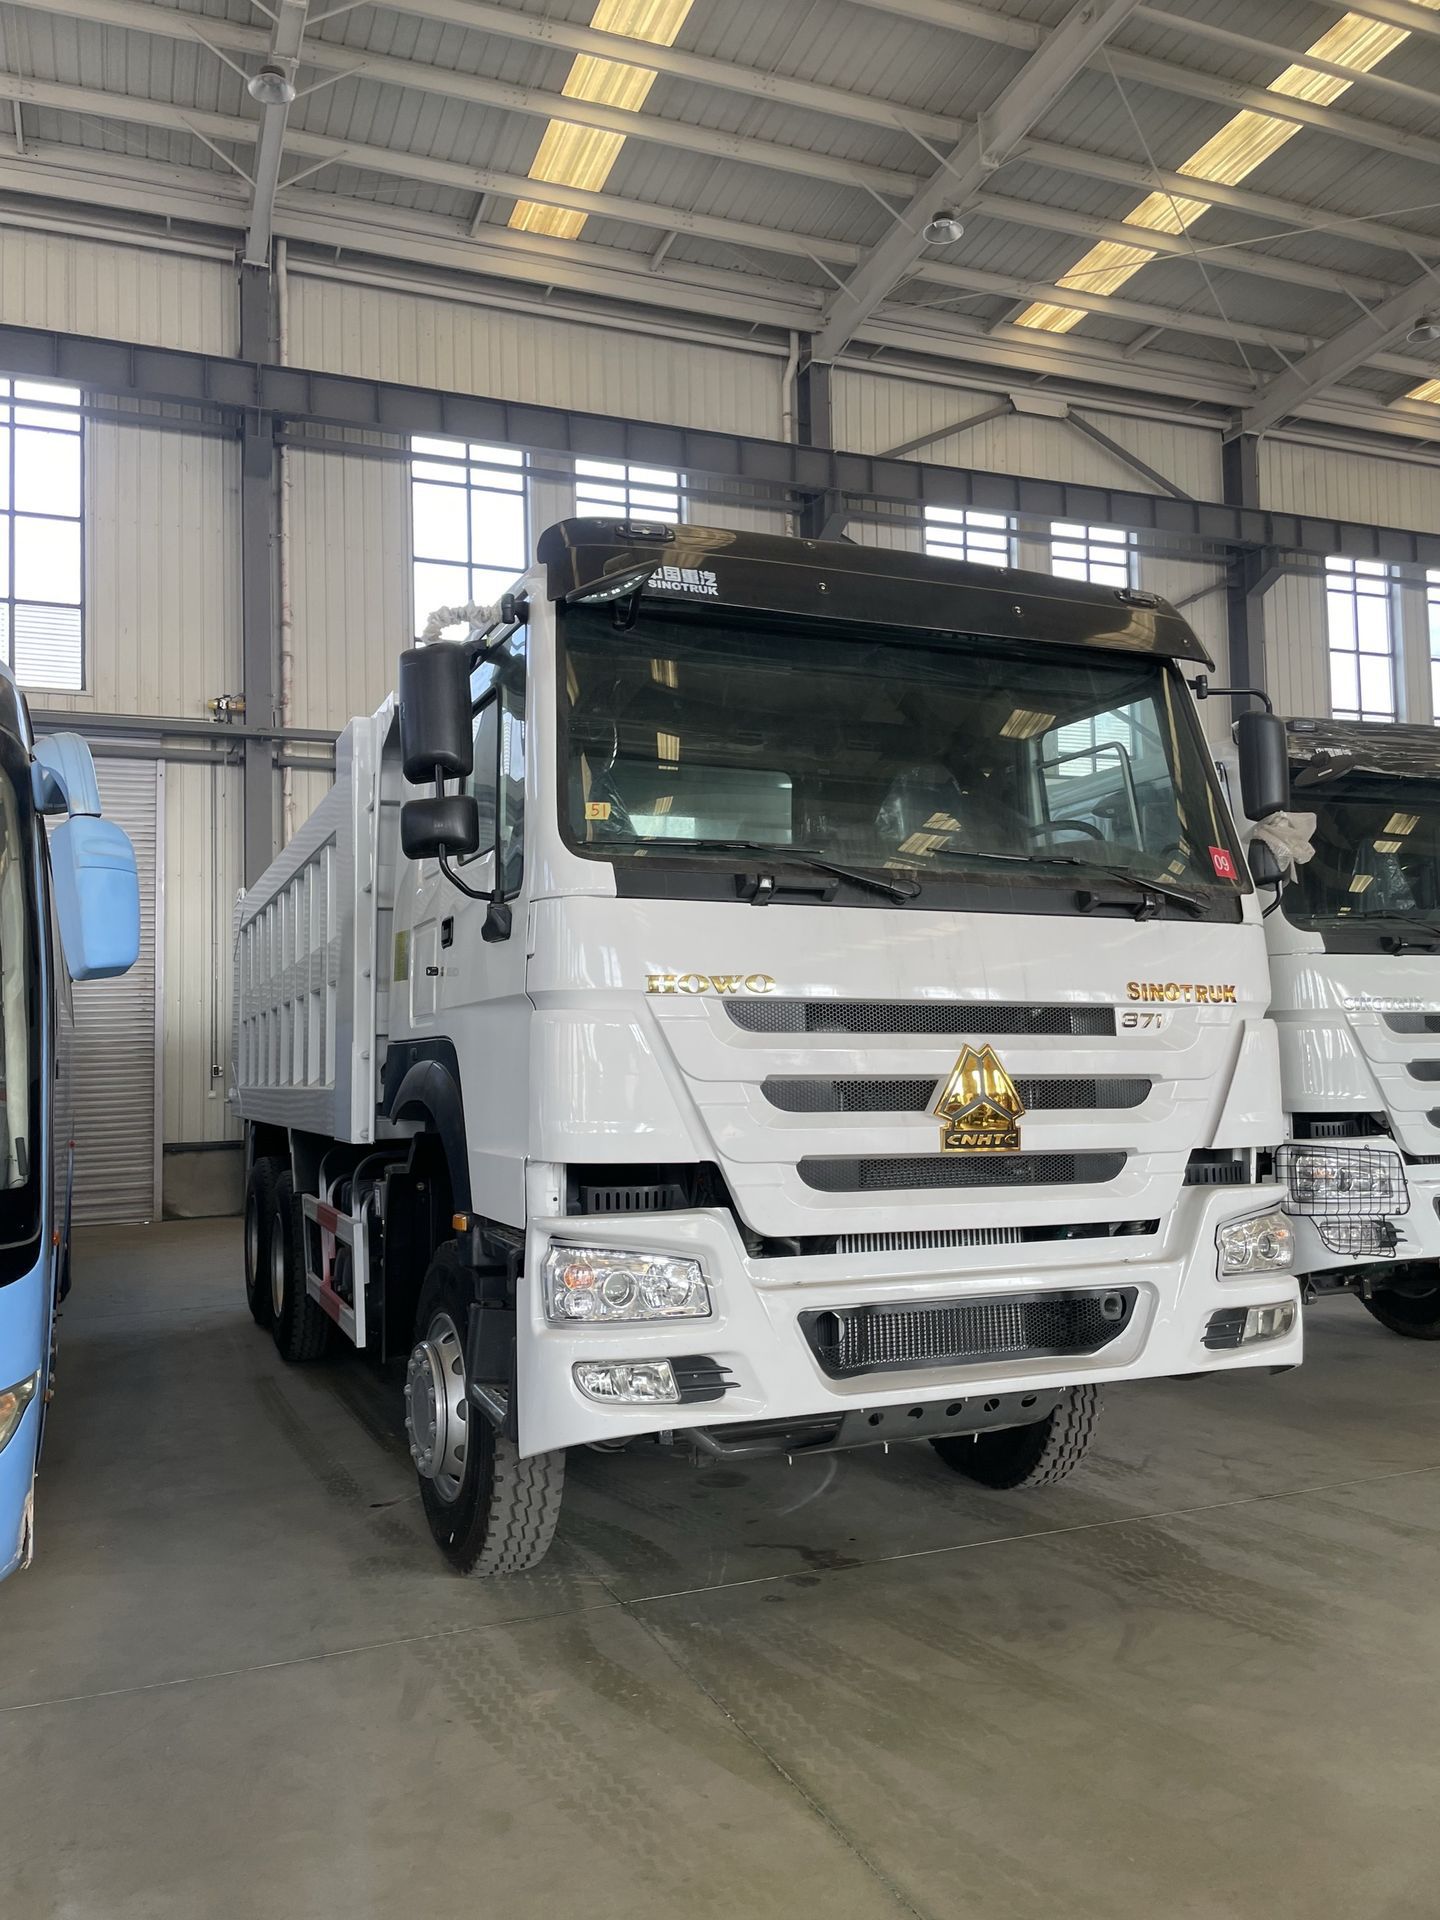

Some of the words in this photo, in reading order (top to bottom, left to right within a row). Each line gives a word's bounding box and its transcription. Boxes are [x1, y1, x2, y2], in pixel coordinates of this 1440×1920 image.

[647, 579, 719, 596] SINOTRUK
[591, 803, 606, 817] 51
[1214, 854, 1230, 872] 09
[645, 973, 777, 994] HOWO
[1126, 981, 1238, 1004] SINOTRUK
[1121, 1012, 1163, 1029] 371
[946, 1133, 1017, 1146] CNHTC
